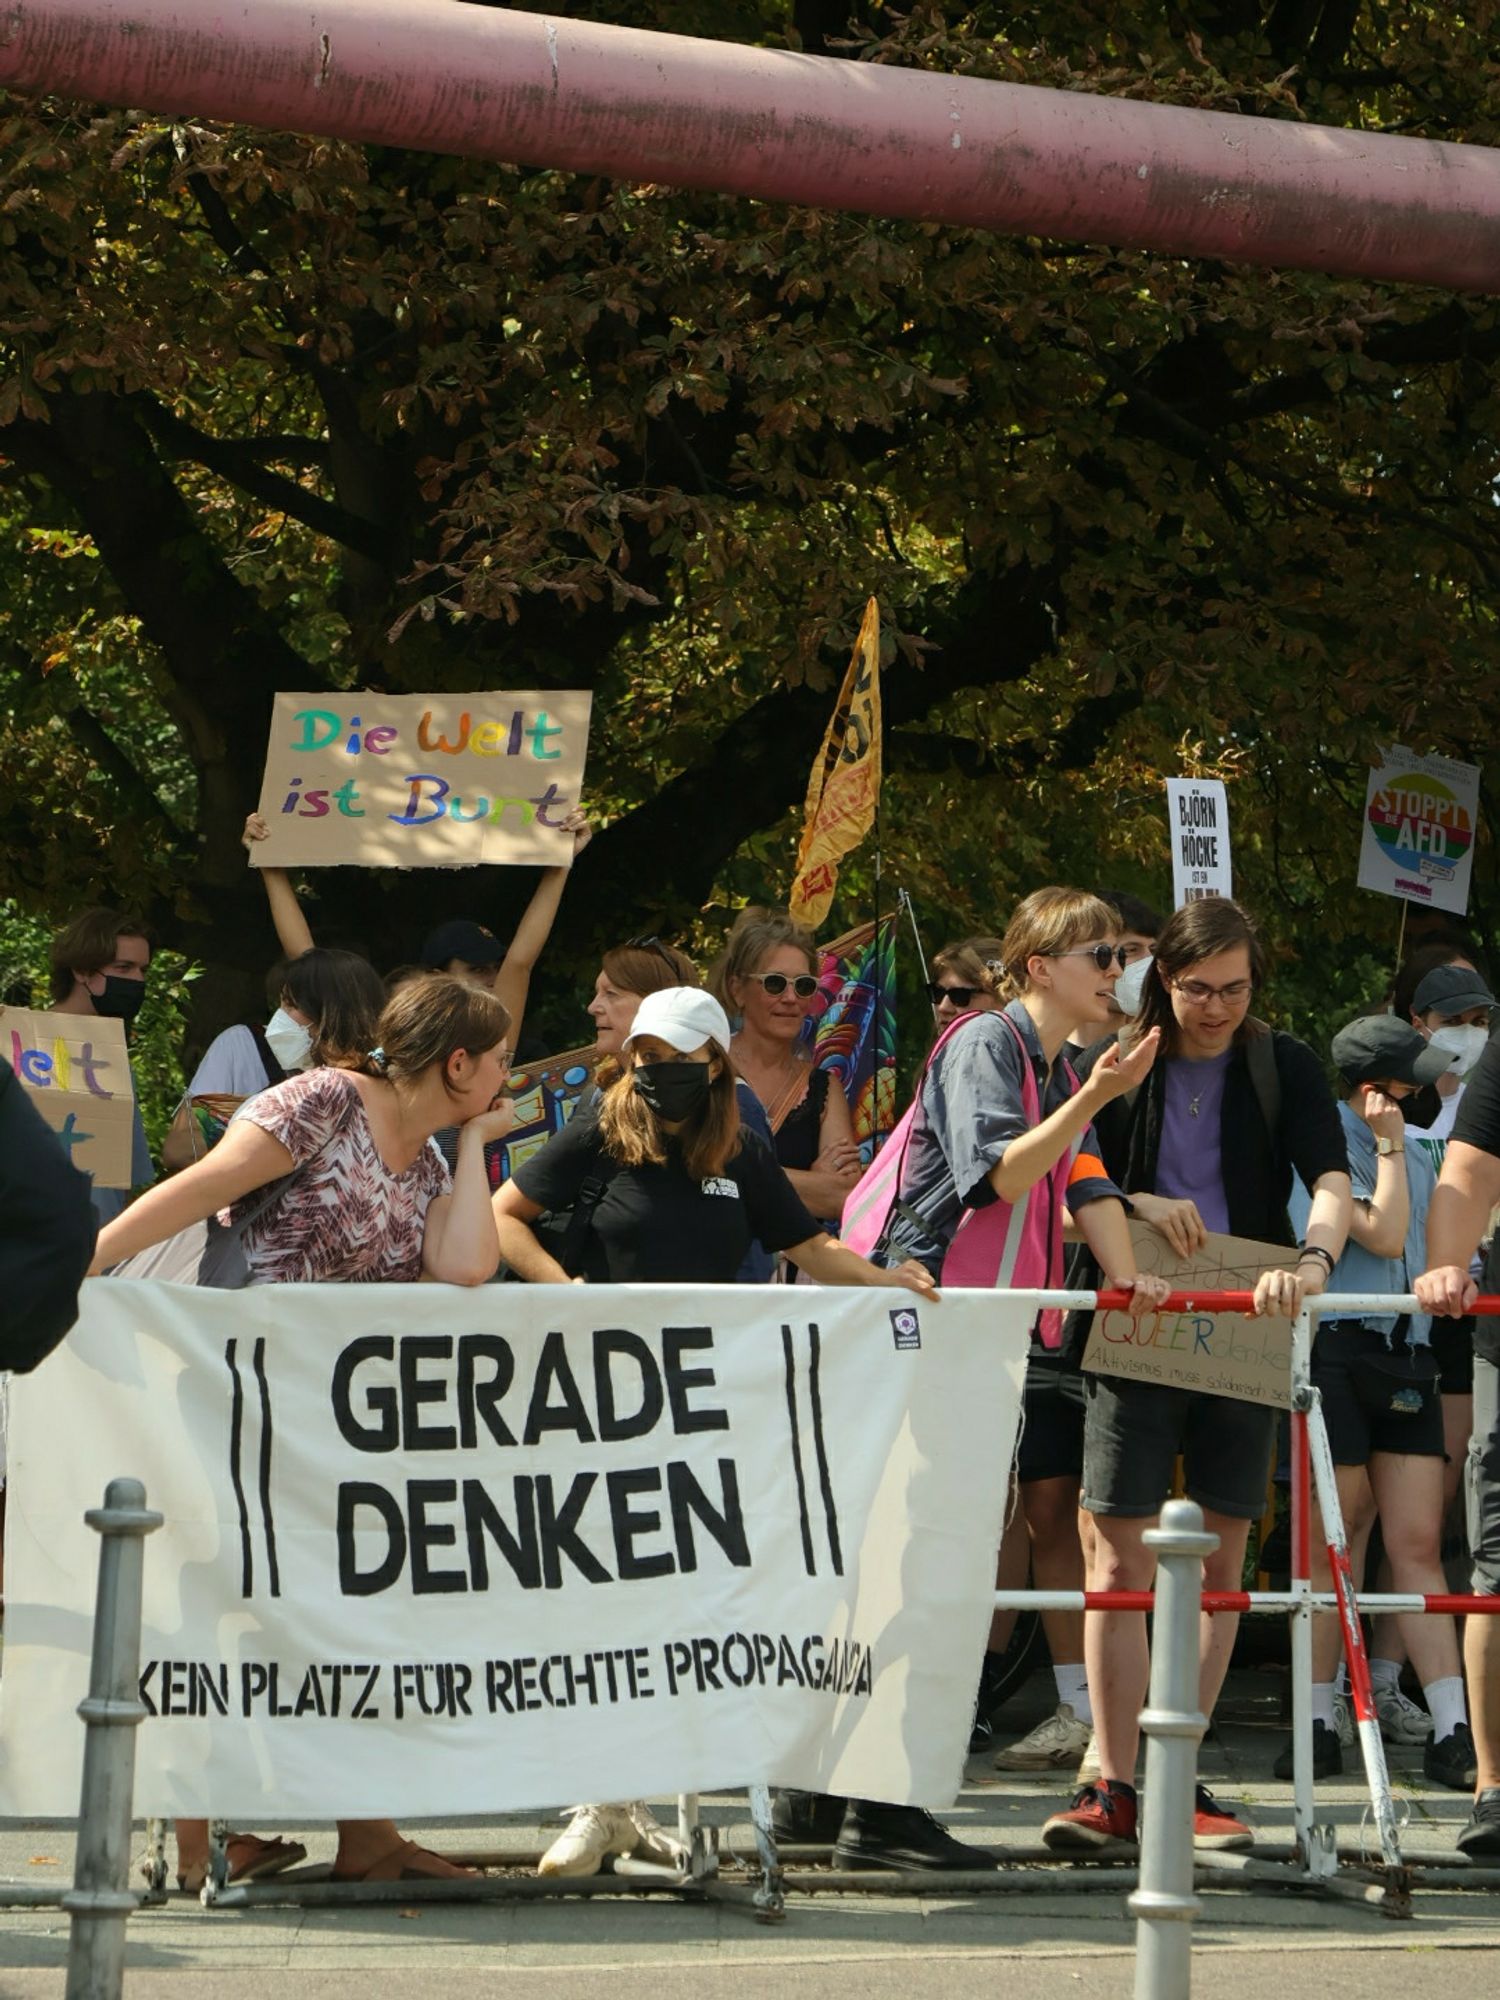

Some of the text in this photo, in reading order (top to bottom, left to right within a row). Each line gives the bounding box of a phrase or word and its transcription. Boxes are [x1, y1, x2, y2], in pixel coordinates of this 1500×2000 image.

[290, 709, 564, 760] Die Welt
[281, 774, 570, 828] ist Bunt
[1178, 789, 1217, 828] BJÖRN
[1376, 787, 1466, 828] STOPPT
[1181, 828, 1219, 868] HÖCKE
[1395, 818, 1448, 858] AFD
[331, 1327, 730, 1453] GERADE
[337, 1458, 751, 1596] DENKEN
[241, 1662, 380, 1718] PLATZ
[393, 1663, 472, 1720] FÜR
[486, 1648, 655, 1714] RECHTE
